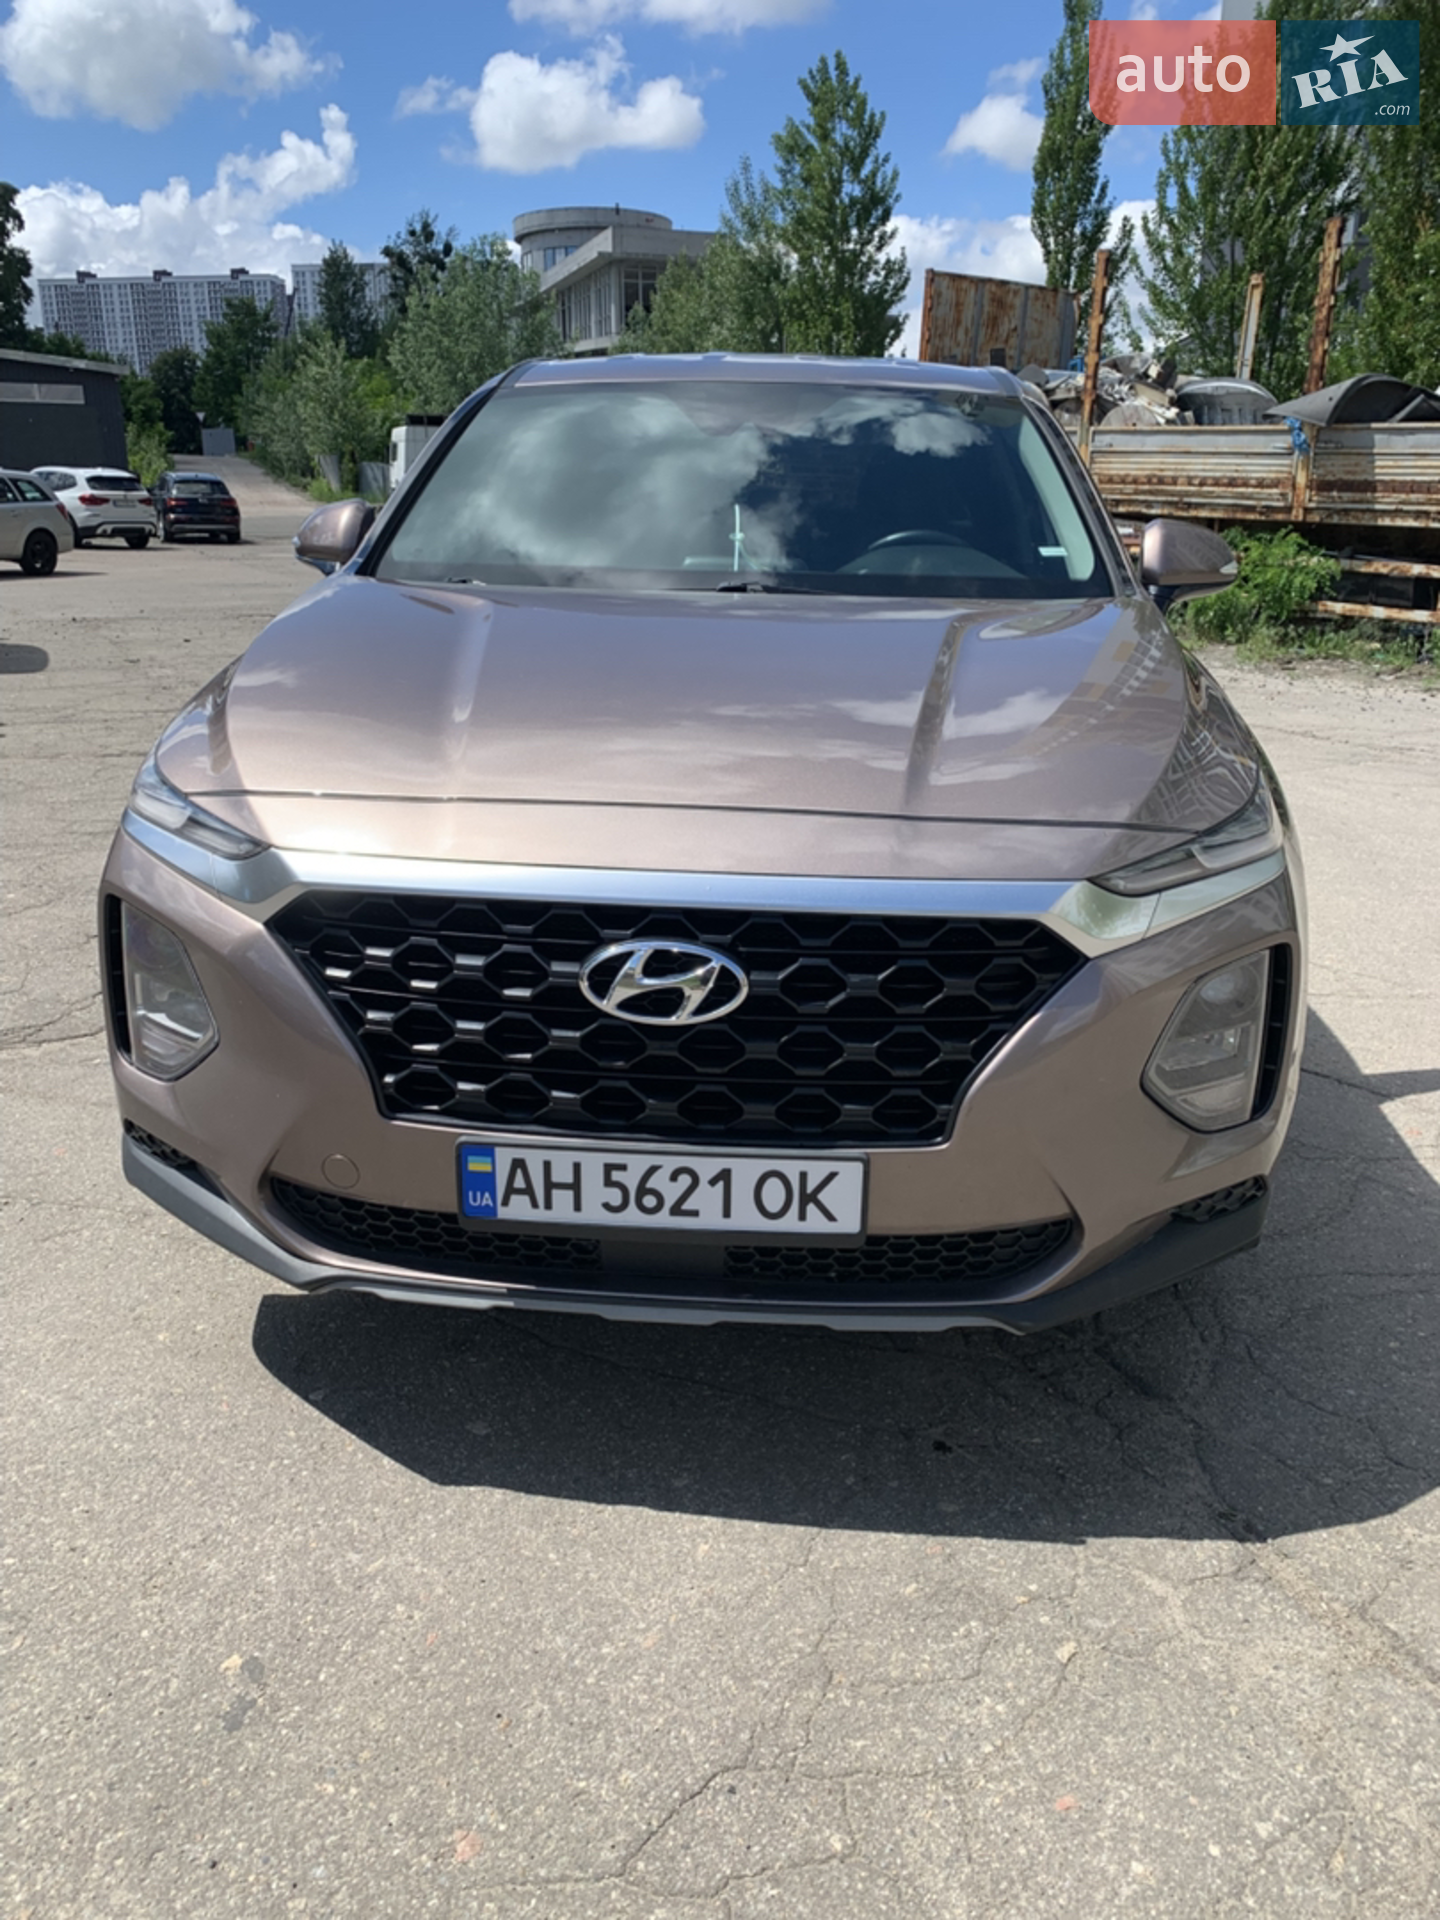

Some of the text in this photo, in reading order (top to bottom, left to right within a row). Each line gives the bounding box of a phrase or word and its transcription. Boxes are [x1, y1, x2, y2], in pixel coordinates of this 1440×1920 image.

[468, 1190, 493, 1207] UA
[501, 1157, 840, 1222] AH 5621 OK
